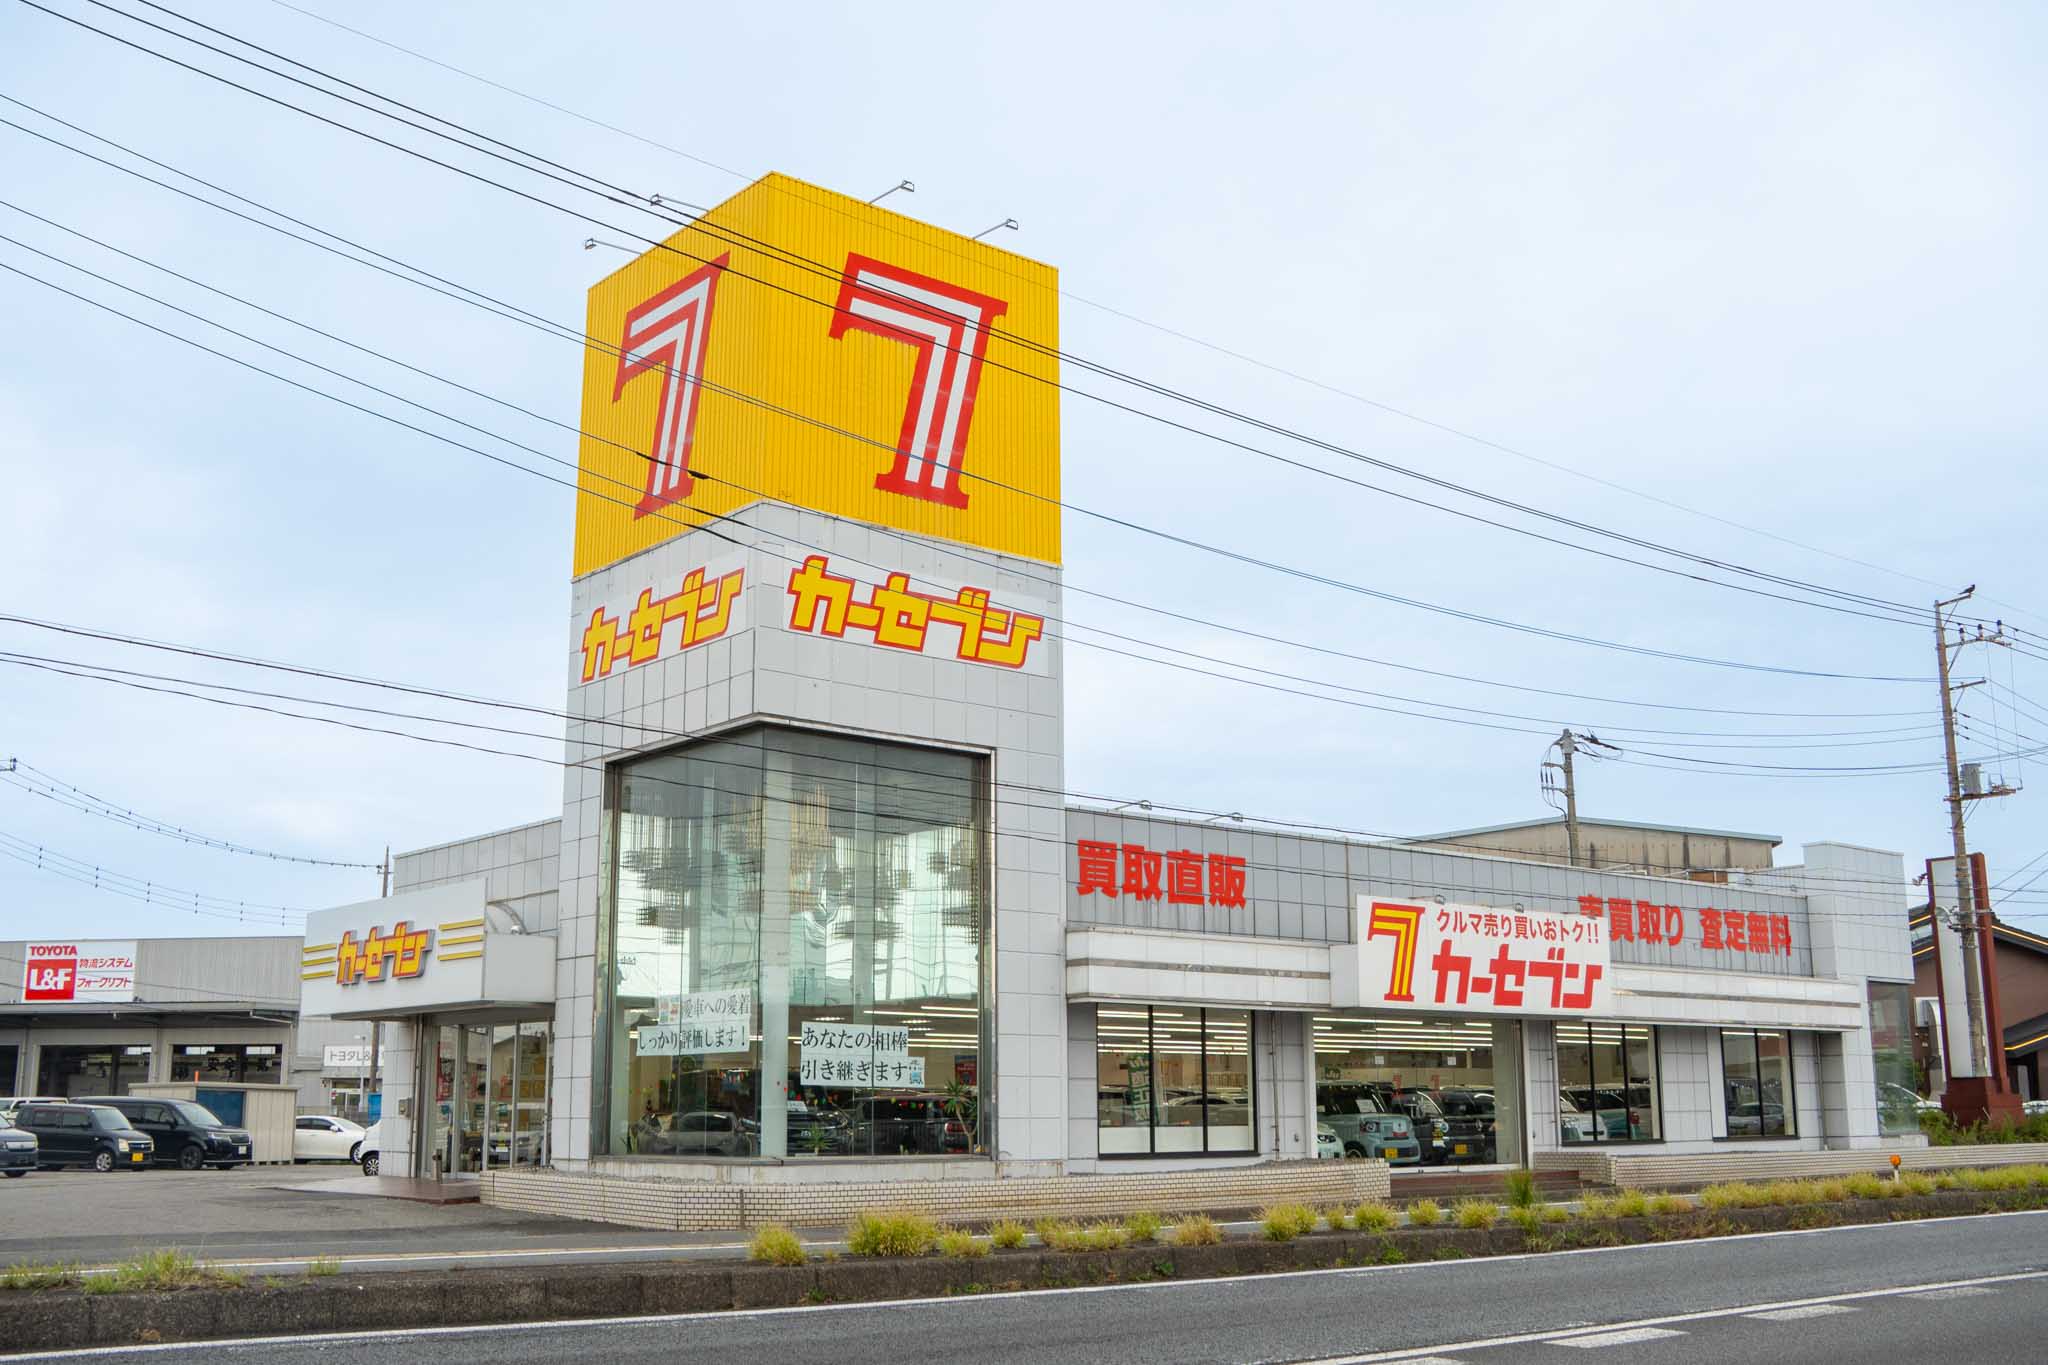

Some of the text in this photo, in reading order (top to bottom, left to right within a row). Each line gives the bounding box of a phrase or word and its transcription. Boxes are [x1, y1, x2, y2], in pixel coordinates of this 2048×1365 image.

[612, 250, 731, 522] 7
[828, 251, 1009, 511] 7
[580, 566, 745, 683] カーセブン
[787, 554, 1045, 669] カーセブン
[1076, 839, 1247, 910] 買取直販
[30, 945, 78, 956] TOYOTA
[1367, 901, 1426, 1002] 7
[1436, 908, 1600, 944] クルマ売り買いおトク!!
[1699, 906, 1792, 957] 査定無料
[79, 957, 133, 969] 物流システム
[336, 921, 432, 985] カーセブン
[1431, 939, 1603, 1009] カーセブン
[29, 968, 73, 991] L&F
[77, 976, 133, 988] フォークリフト
[638, 1024, 746, 1052] しっかり評価します!
[801, 1027, 908, 1052] あなたの相棒
[800, 1058, 910, 1083] 引き継ぎます
